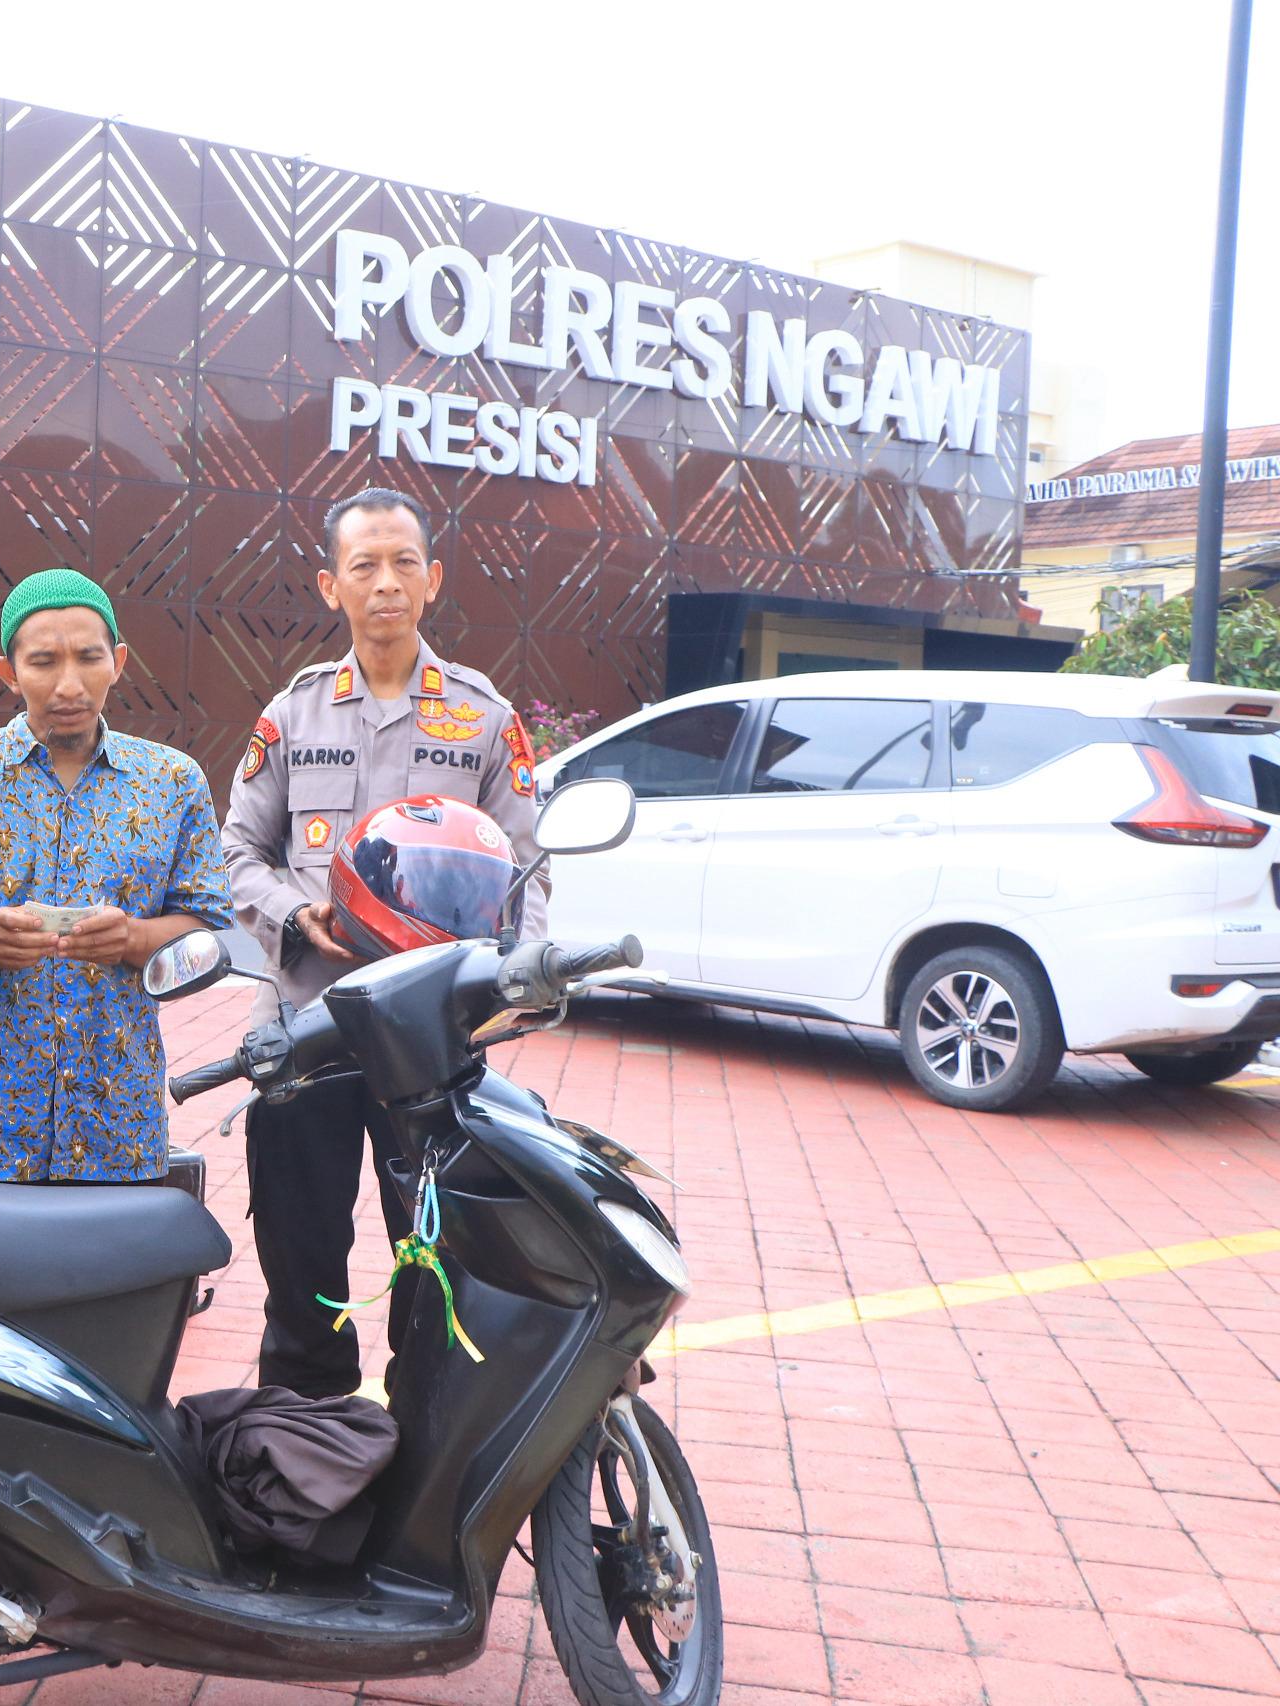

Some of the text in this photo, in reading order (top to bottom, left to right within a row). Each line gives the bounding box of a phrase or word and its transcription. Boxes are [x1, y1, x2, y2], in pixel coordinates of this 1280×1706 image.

[335, 229, 1000, 455] POLRES NGAWI
[330, 376, 597, 486] PRESISI
[1076, 466, 1177, 498] PARAMA
[291, 748, 355, 767] KARNO
[414, 748, 481, 770] POLRI
